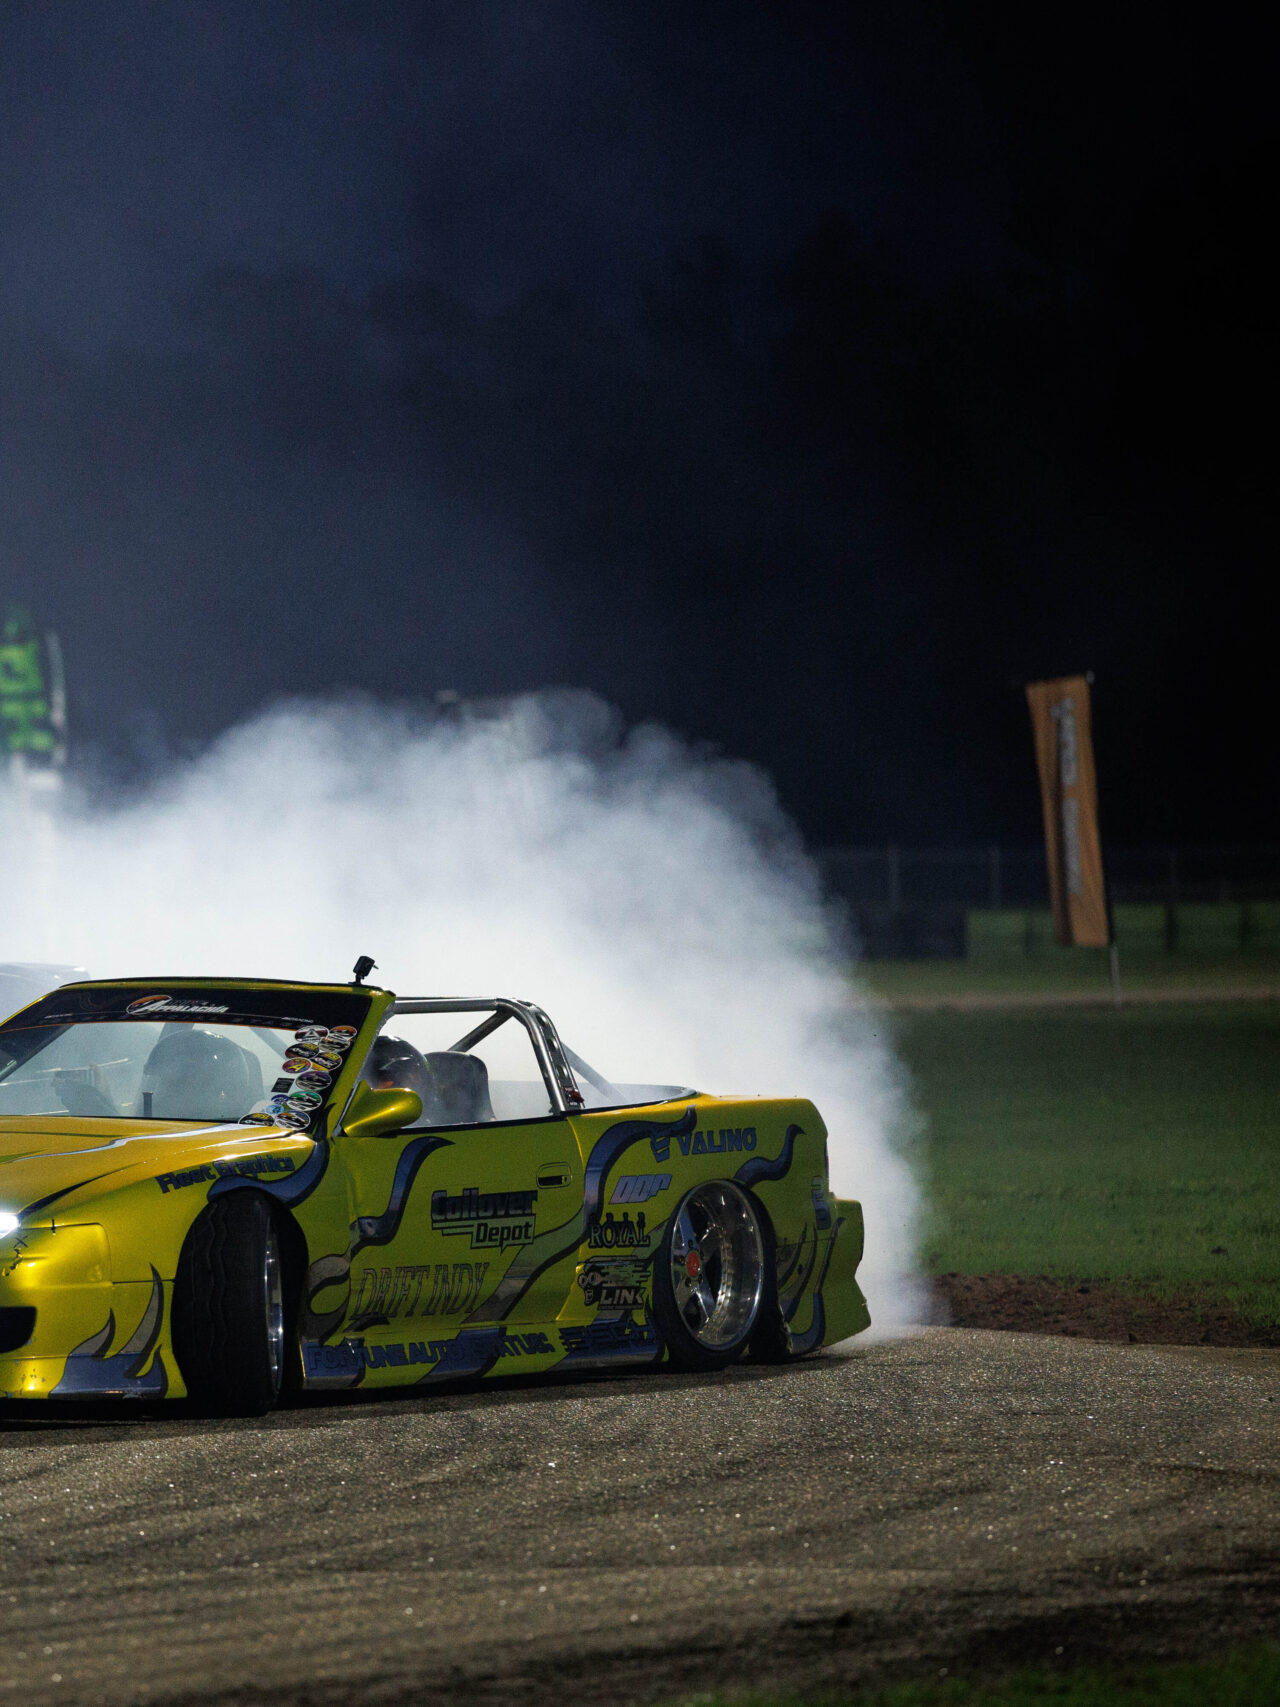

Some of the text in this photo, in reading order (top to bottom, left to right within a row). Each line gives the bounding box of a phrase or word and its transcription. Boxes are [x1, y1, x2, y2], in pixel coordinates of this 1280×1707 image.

[676, 1127, 757, 1156] VALINO
[211, 1154, 296, 1180] Graphics
[431, 1187, 538, 1220] Coilover
[475, 1221, 533, 1243] Depot
[588, 1217, 651, 1249] ROYAL
[350, 1261, 490, 1321] DRIFT INDY
[307, 1343, 409, 1371] FORTUNE
